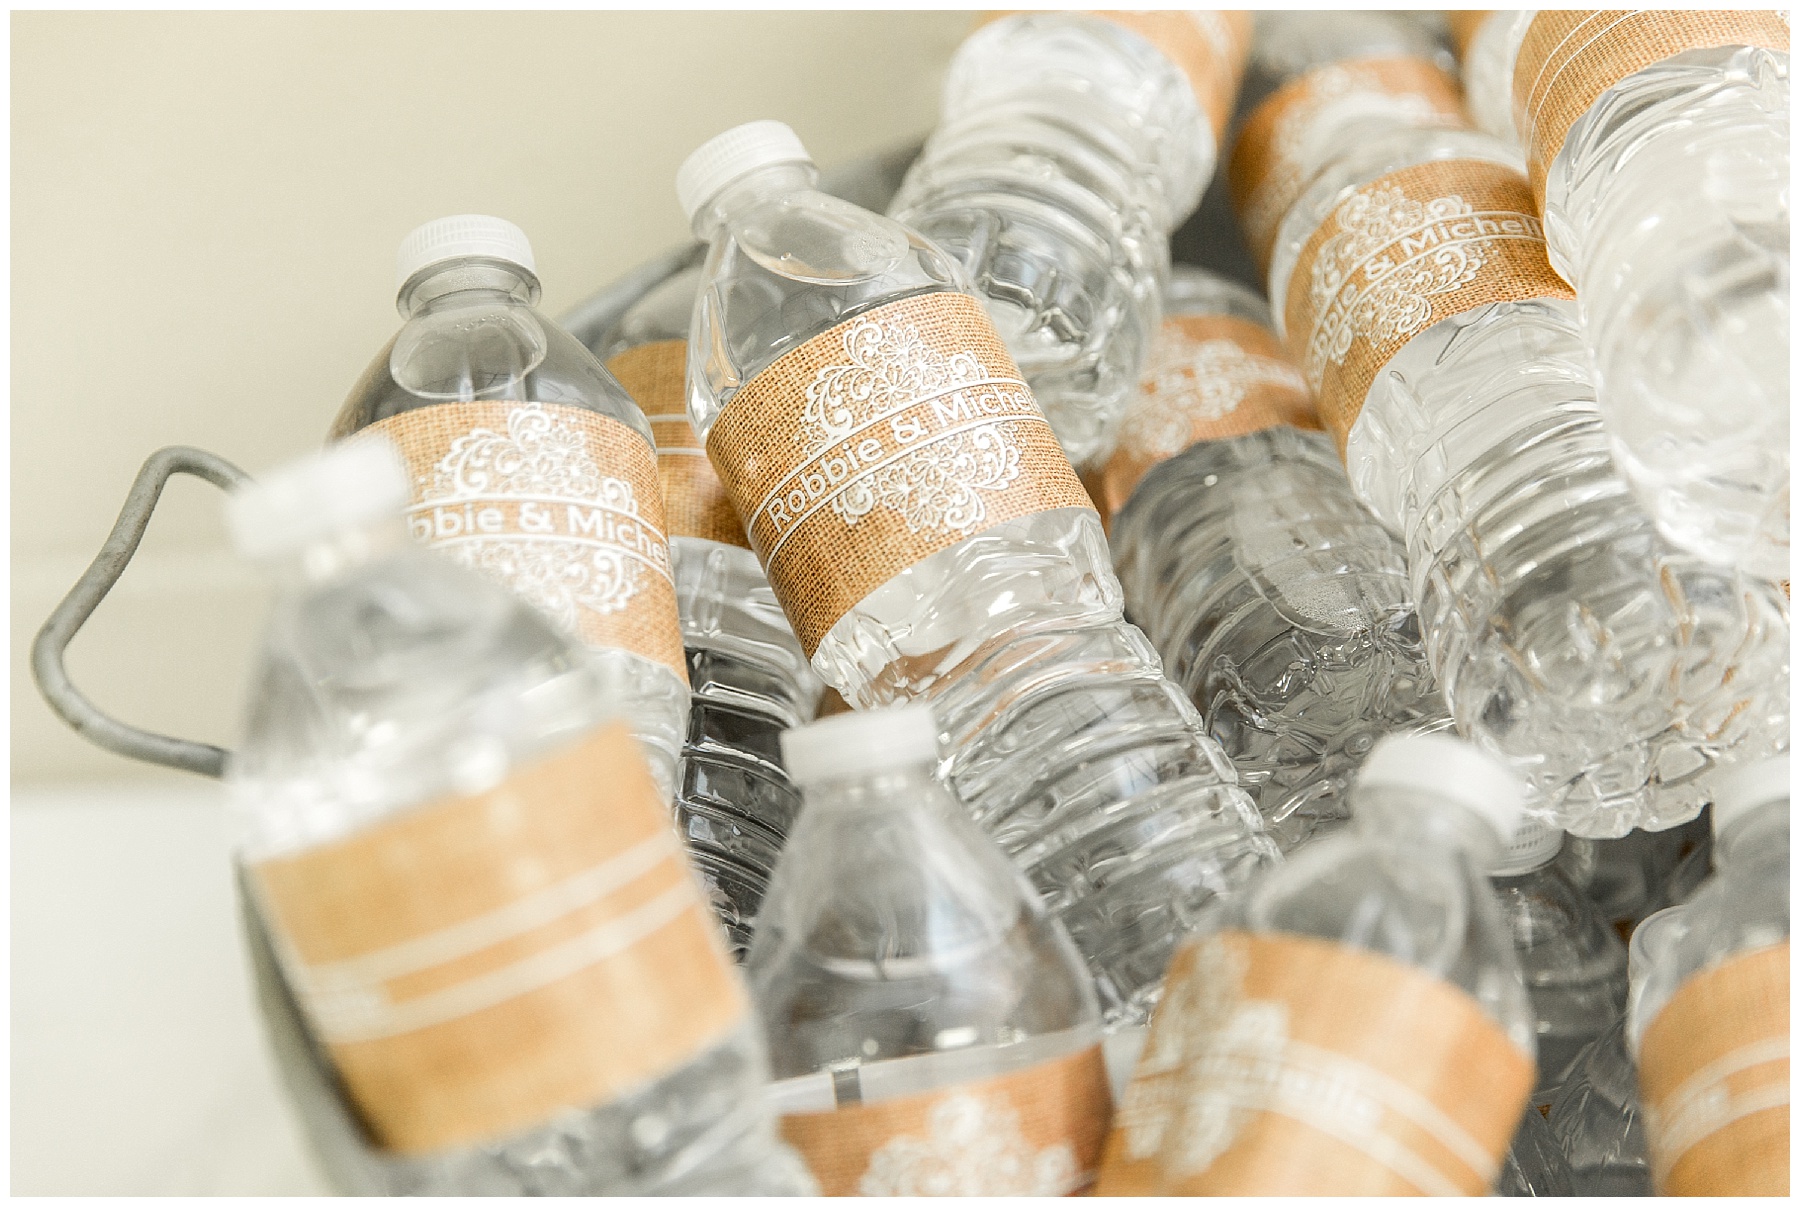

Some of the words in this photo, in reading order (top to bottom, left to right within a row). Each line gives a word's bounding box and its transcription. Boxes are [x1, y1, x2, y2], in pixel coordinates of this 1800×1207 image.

[1365, 258, 1395, 280] &
[1400, 217, 1542, 257] Michell
[766, 436, 884, 533] Robbie
[890, 416, 929, 443] &
[932, 385, 1041, 427] Michell
[406, 502, 504, 543] bbie
[518, 502, 553, 532] &
